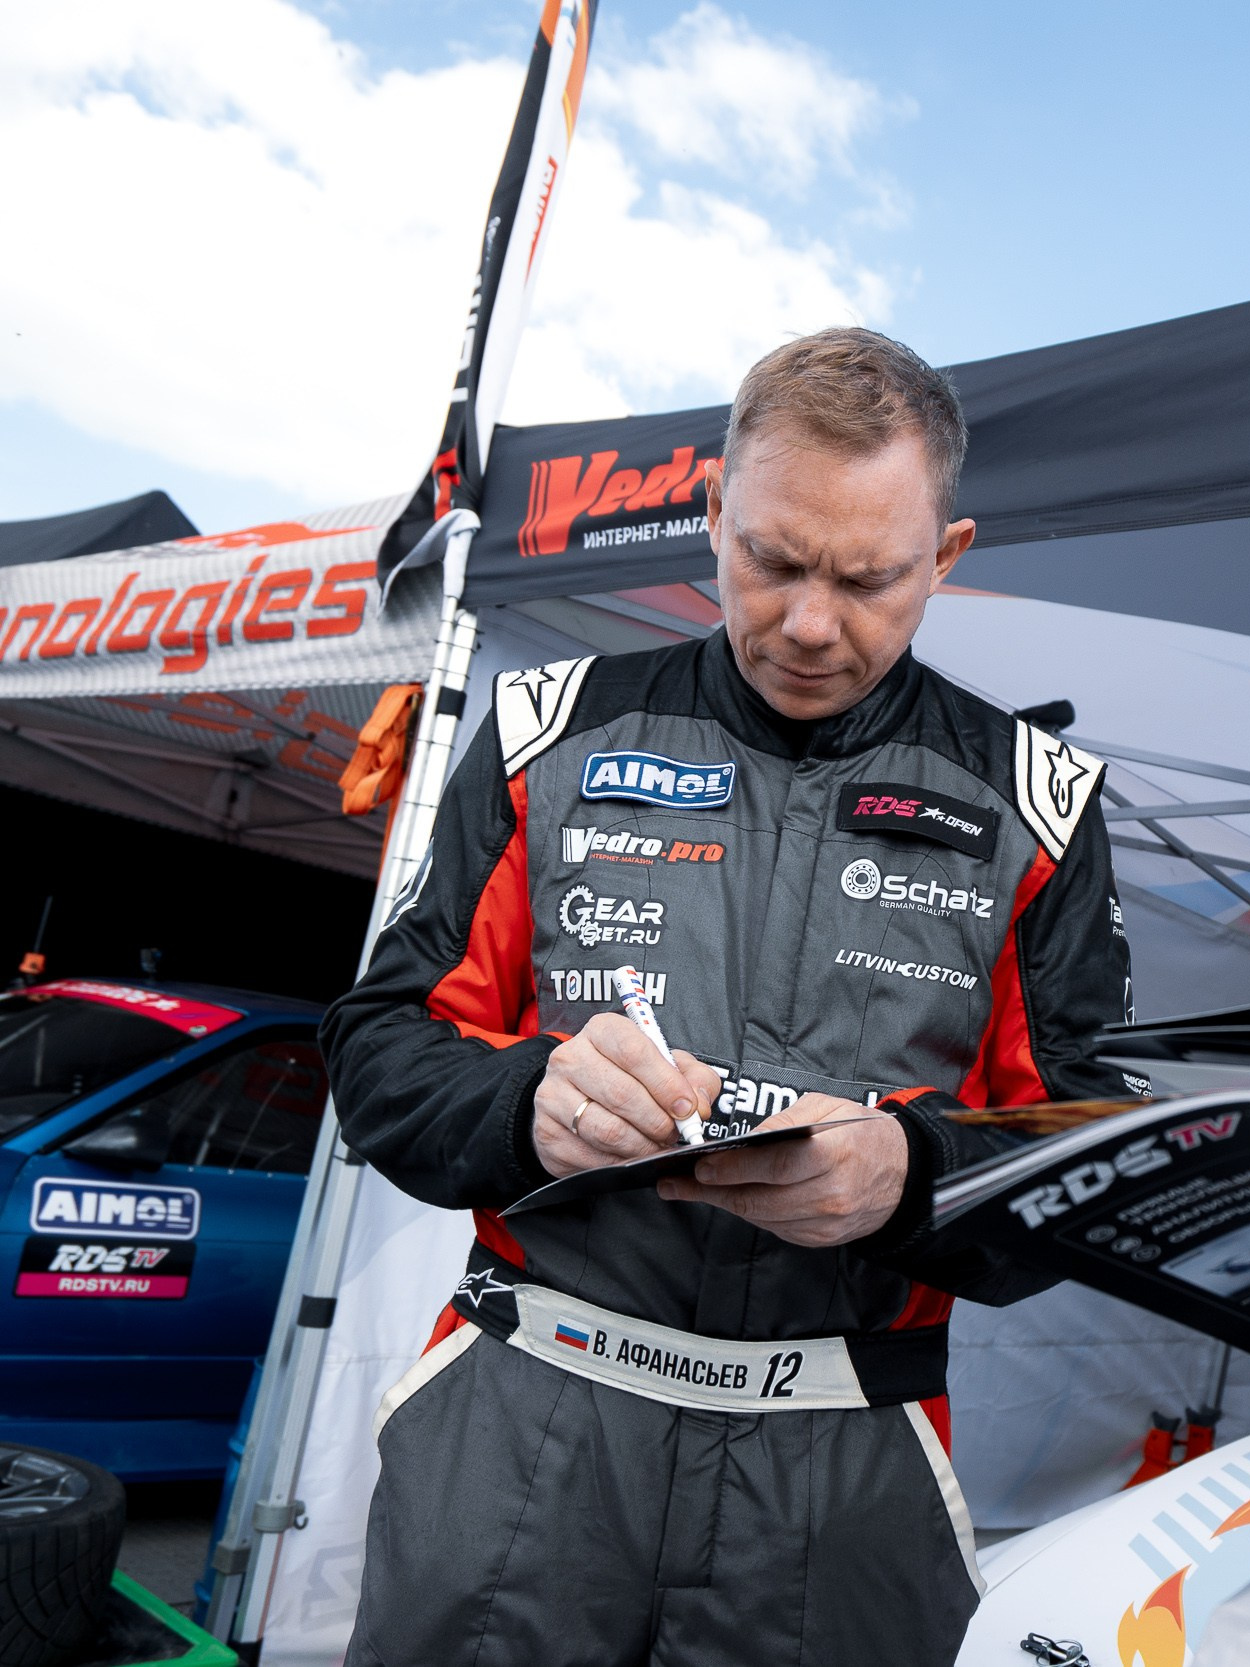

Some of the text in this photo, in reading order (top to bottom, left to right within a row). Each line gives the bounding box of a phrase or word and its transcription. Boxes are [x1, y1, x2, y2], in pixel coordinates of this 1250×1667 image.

[590, 761, 727, 798] AIMOL
[853, 796, 983, 837] RDS OPEN
[562, 826, 724, 862] Vedro.pro
[589, 853, 654, 865] НТЕРНЕТ-МАГАЗИН
[559, 884, 664, 934] GEAR
[879, 899, 951, 917] GERMAN QUALITY
[880, 875, 994, 918] Schatz
[550, 969, 667, 1005] ТОПГН
[1008, 1110, 1243, 1230] RDS TV
[38, 1190, 192, 1229] AIMOL
[48, 1244, 171, 1273] RDS TV
[58, 1277, 151, 1294] RDSTV.RU
[592, 1329, 804, 1399] В. АФАНАСЬЕВ 12
